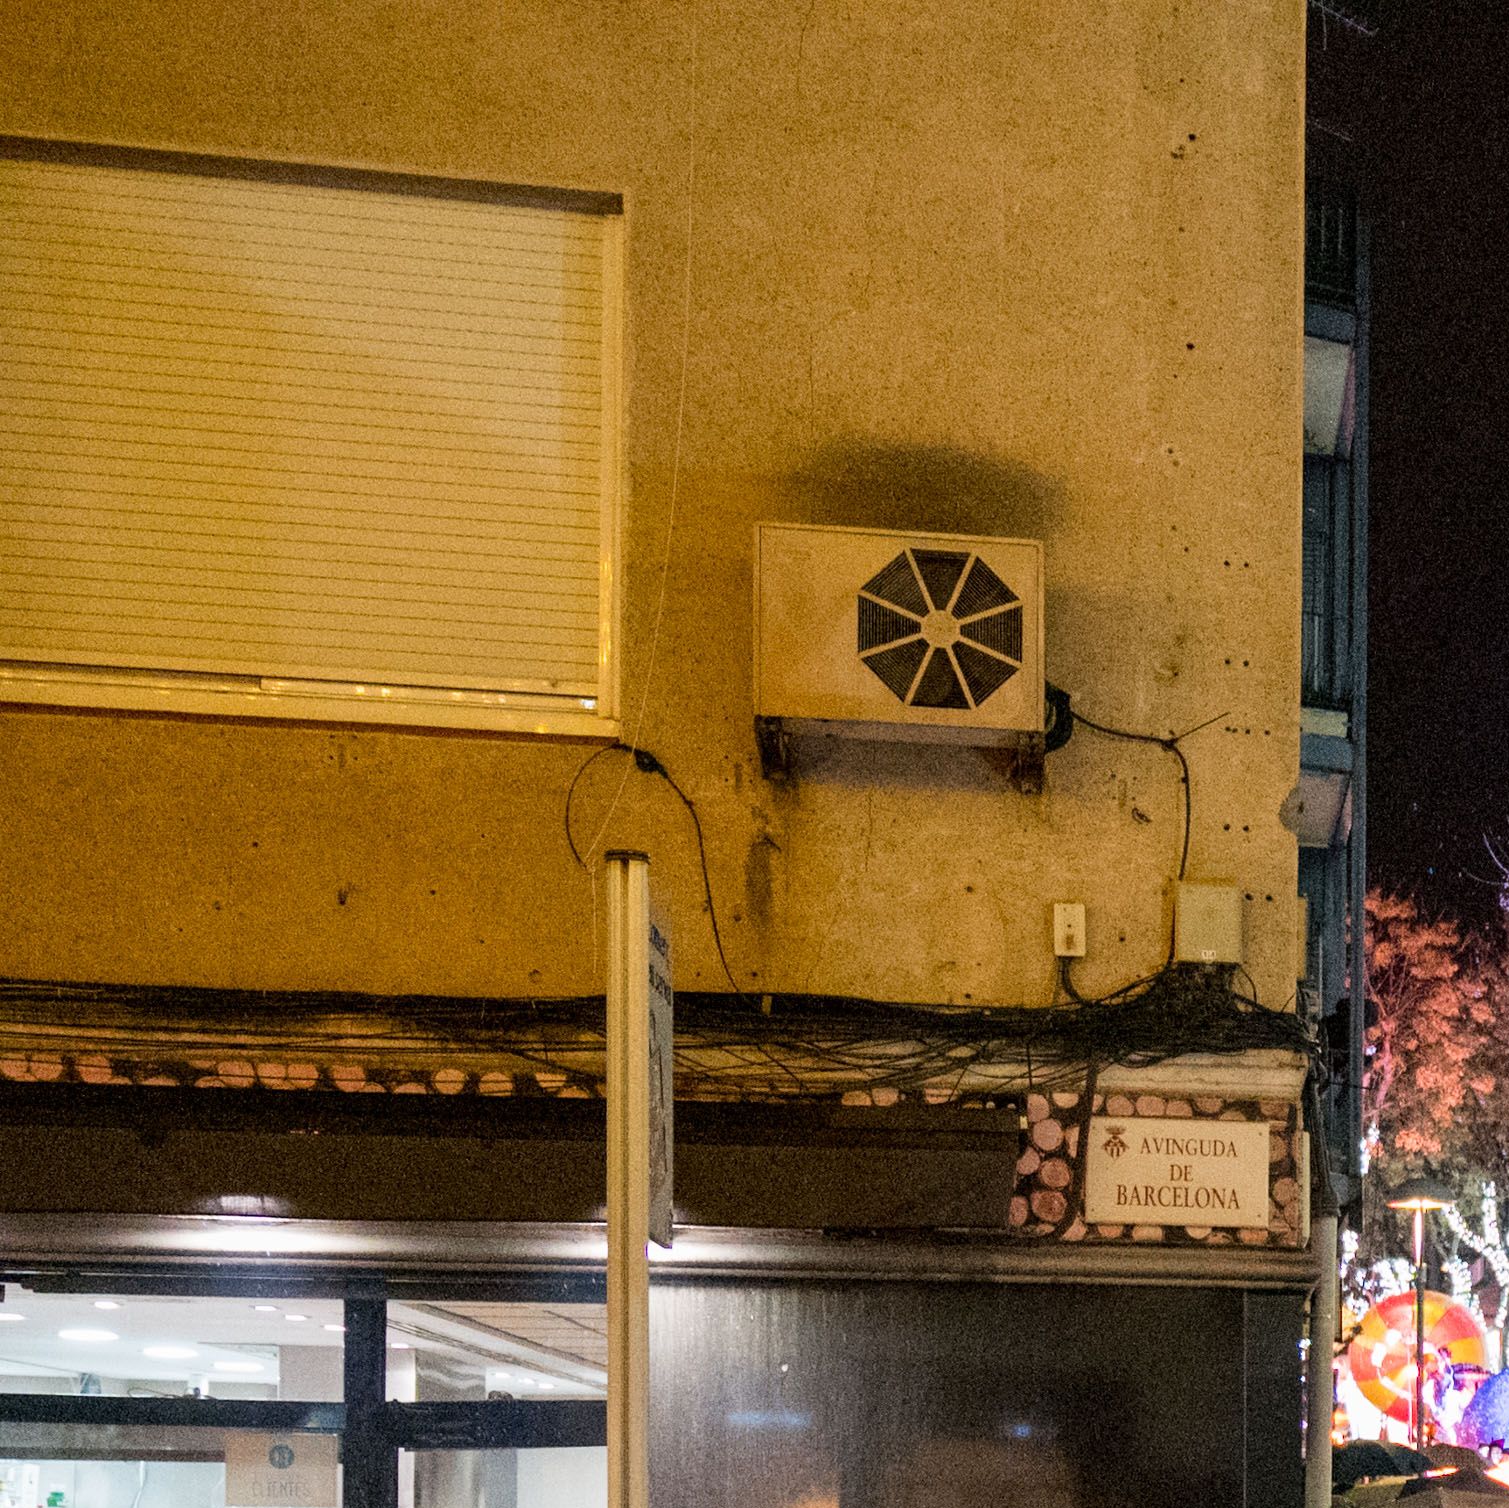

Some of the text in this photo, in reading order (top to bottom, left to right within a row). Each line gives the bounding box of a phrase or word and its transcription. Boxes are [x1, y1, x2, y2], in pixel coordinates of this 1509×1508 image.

[1140, 1136, 1239, 1158] AVINGUDA
[1169, 1164, 1194, 1182] DE
[1116, 1184, 1241, 1210] BARCELONA
